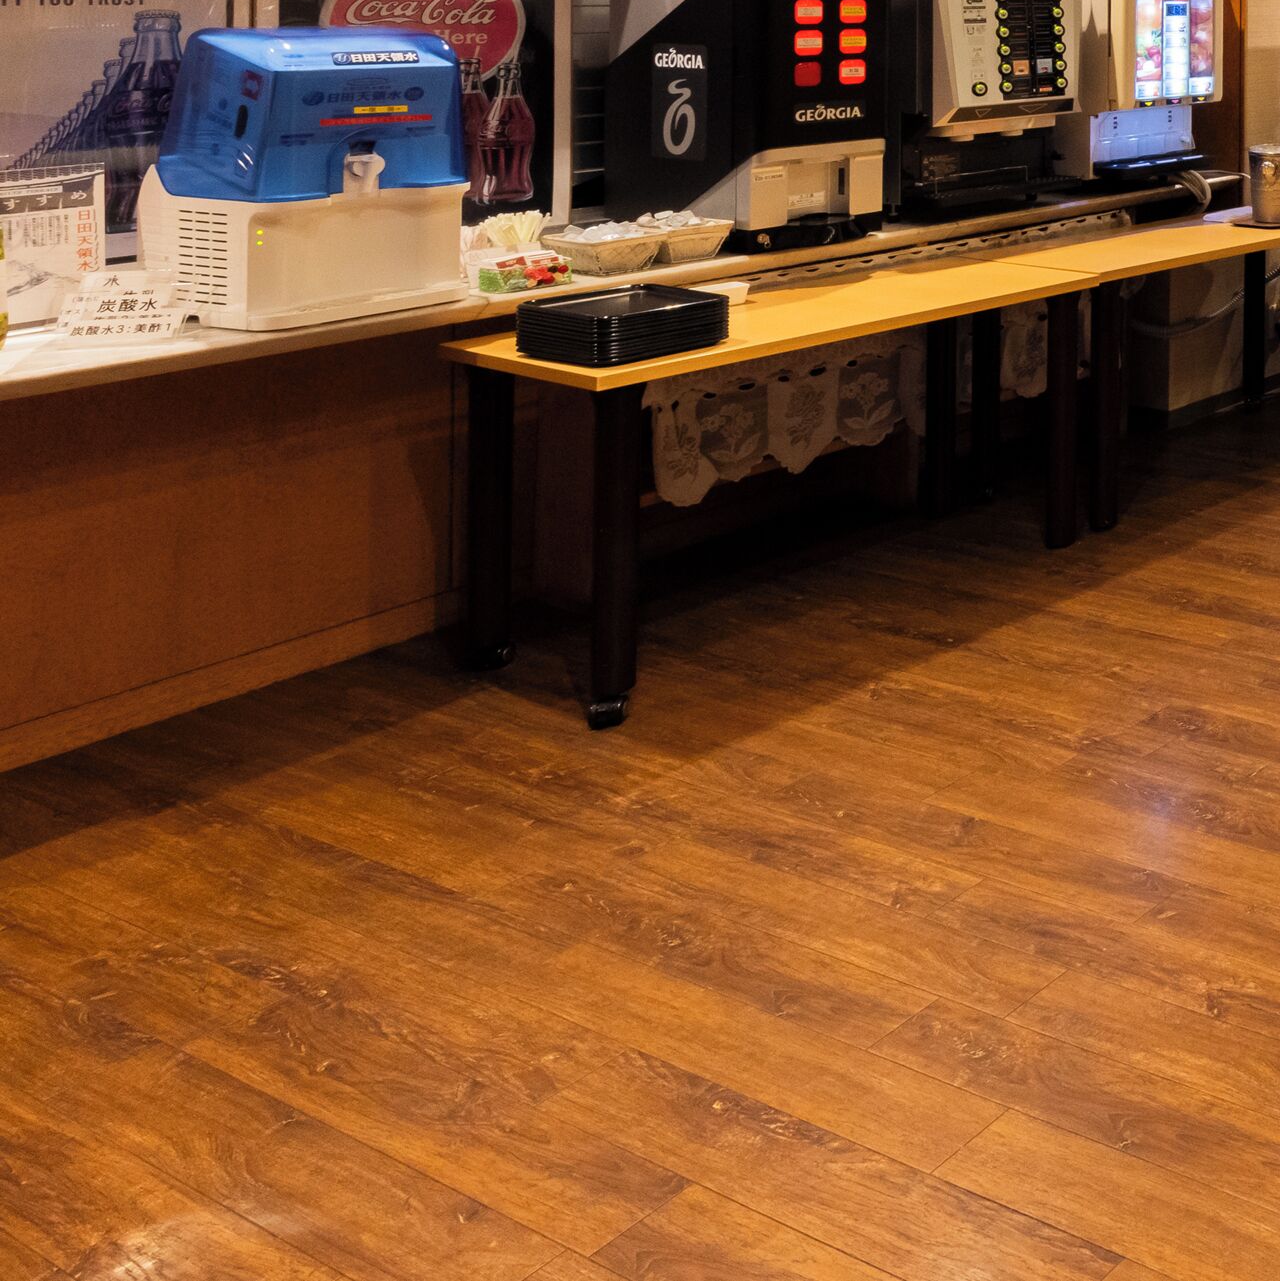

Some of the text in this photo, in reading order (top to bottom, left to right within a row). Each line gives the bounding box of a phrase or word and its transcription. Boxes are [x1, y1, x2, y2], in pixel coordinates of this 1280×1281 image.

[434, 29, 489, 45] Here
[350, 52, 418, 64] 日田天領水
[654, 47, 705, 69] GEORGIA
[795, 103, 864, 122] GEORGIA
[76, 209, 94, 272] 日田天領水
[96, 297, 158, 313] 炭酸水
